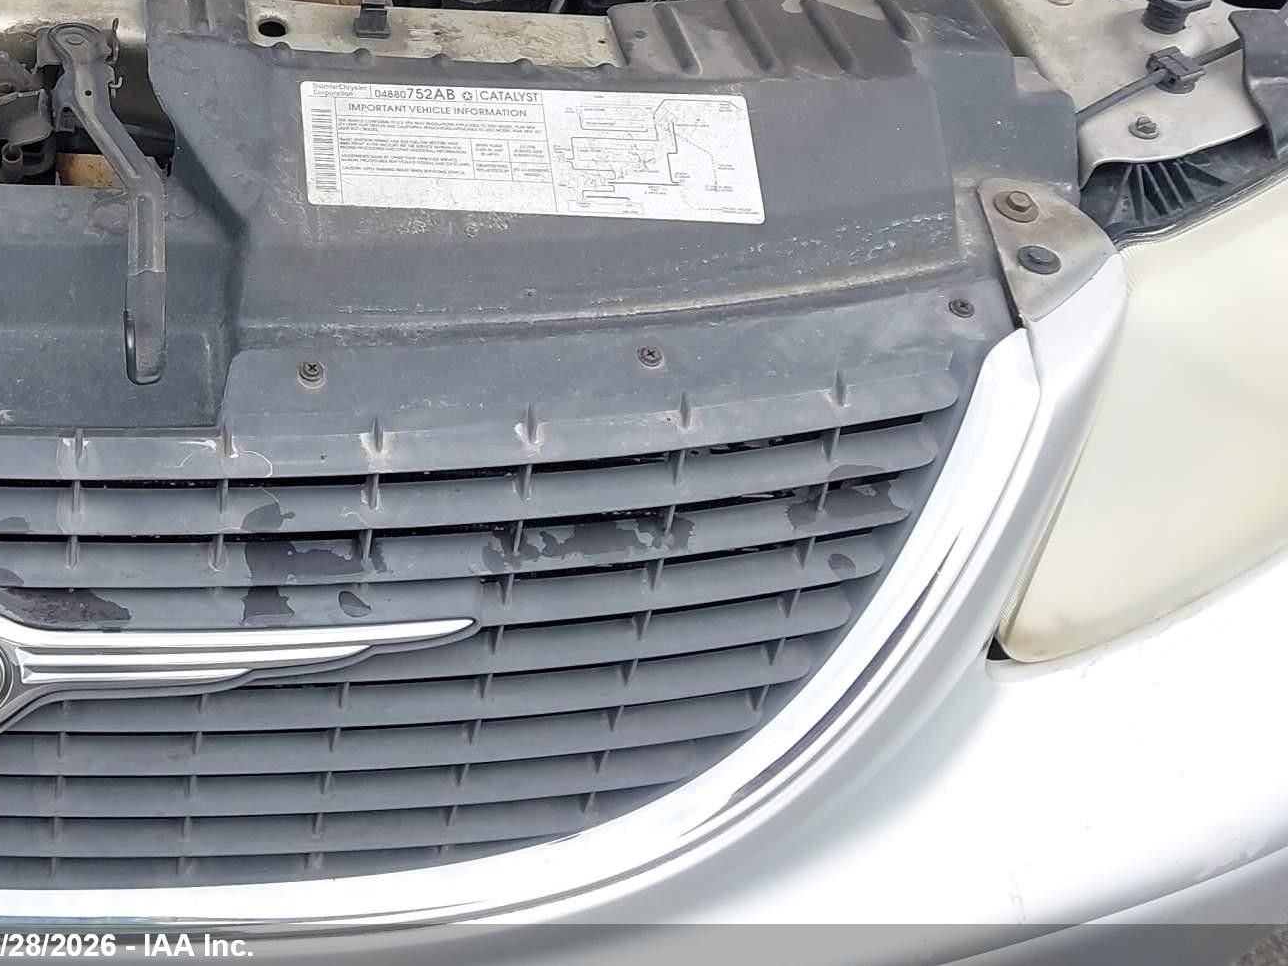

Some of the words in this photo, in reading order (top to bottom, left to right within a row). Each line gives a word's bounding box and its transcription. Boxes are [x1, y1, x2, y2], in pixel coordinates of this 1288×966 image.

[313, 83, 367, 91] DaimlerChrysler
[374, 88, 456, 101] 04880752AB
[479, 91, 538, 102] CATALYST
[348, 103, 409, 113] IMPORTANT
[409, 105, 452, 115] VEHICLE
[453, 106, 527, 117] INFORMATION
